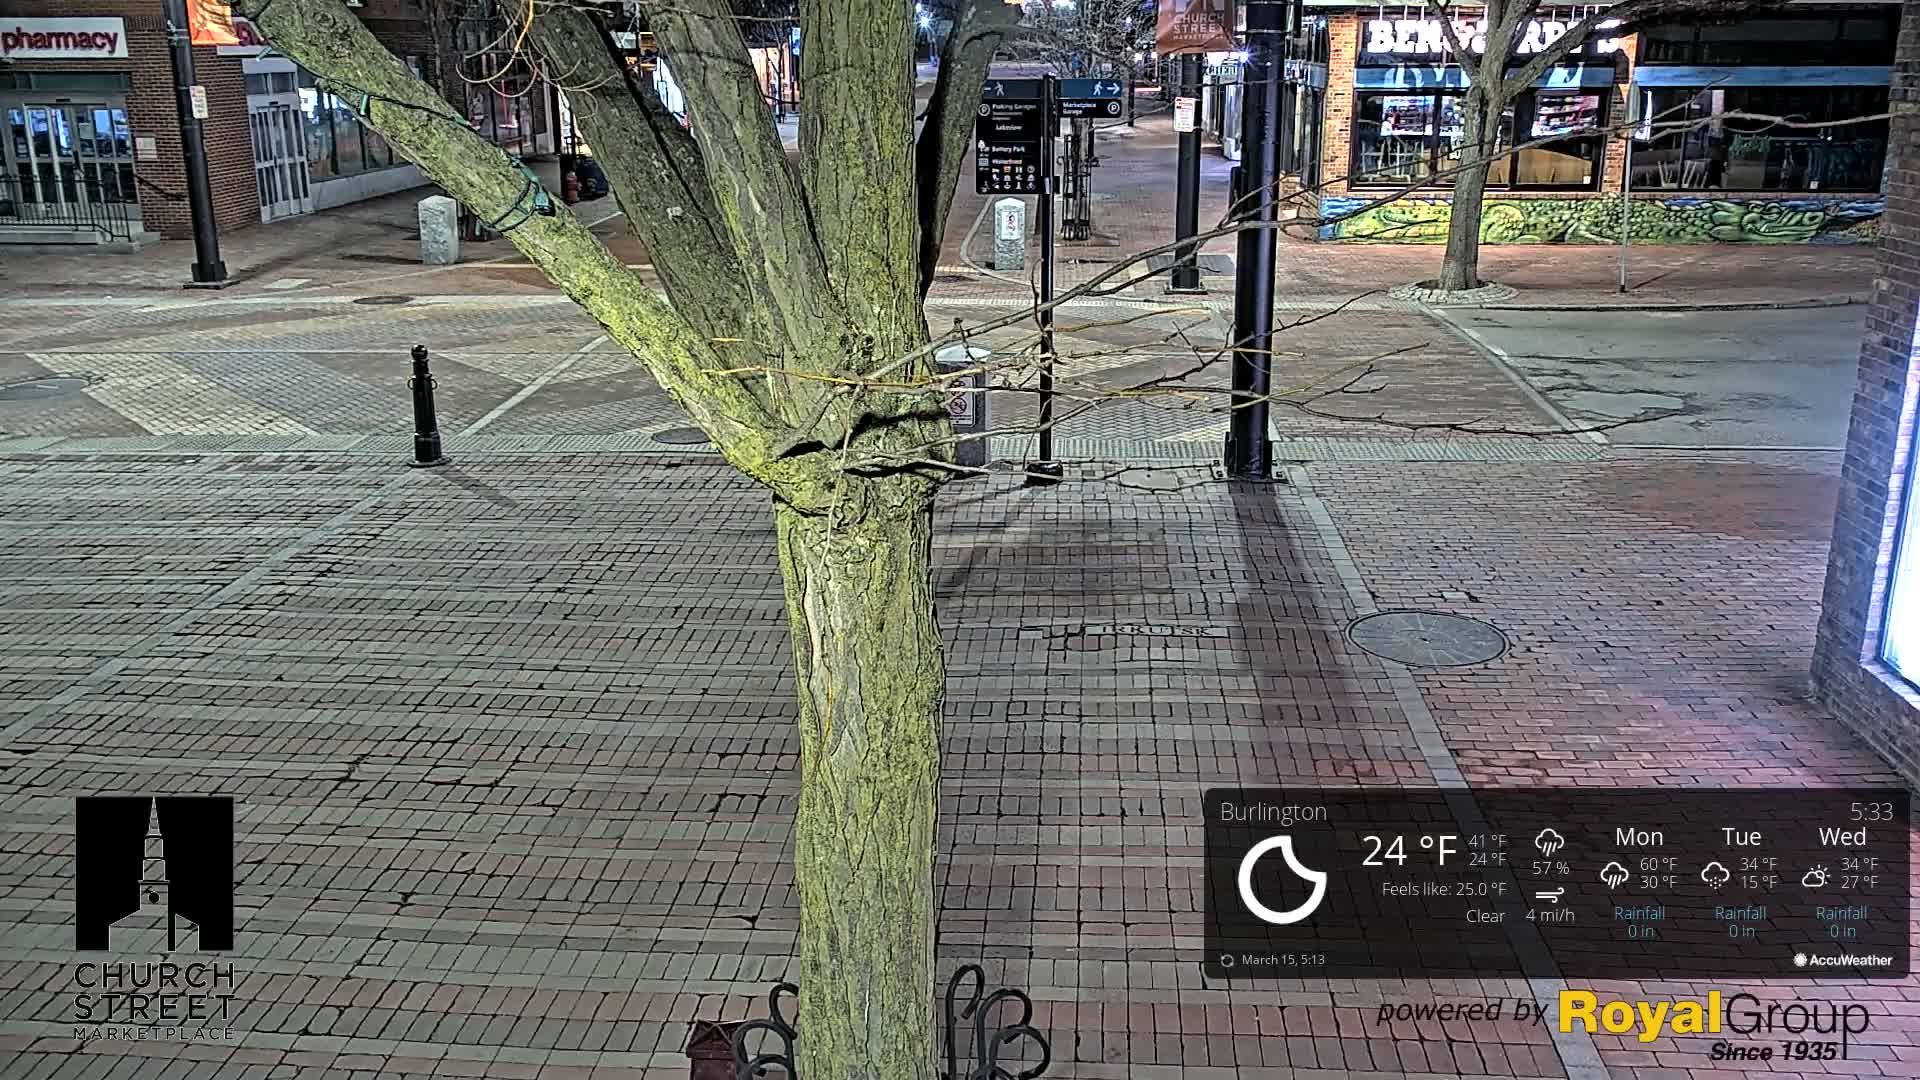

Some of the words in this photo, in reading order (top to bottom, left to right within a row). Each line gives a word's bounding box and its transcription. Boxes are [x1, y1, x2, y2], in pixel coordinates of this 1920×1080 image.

[1173, 12, 1225, 24] CHURCH
[1173, 23, 1226, 34] STREE
[1368, 19, 1441, 53] BEN
[1, 26, 118, 55] pharmacy
